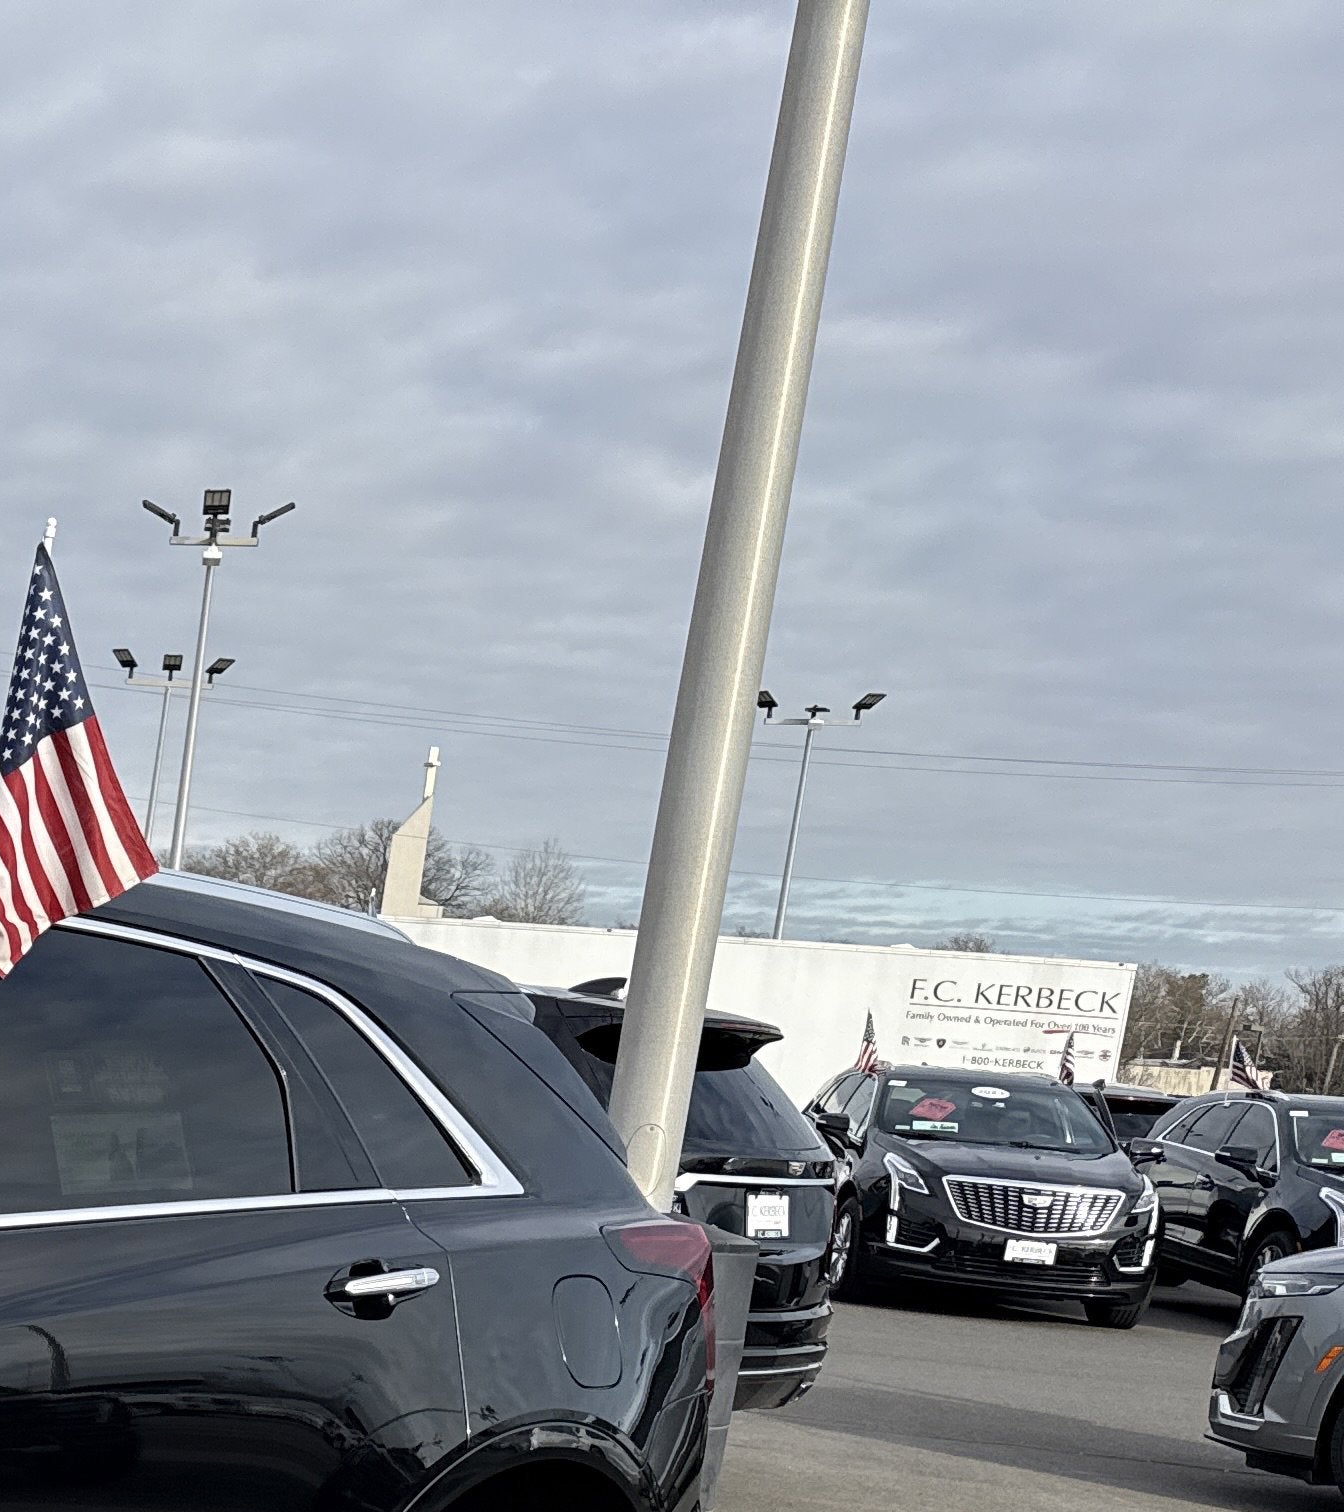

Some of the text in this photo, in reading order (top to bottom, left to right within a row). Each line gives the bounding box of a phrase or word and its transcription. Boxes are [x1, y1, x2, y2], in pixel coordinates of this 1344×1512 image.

[909, 978, 1121, 1014] F.C. KERBECK
[906, 1011, 934, 1023] Family
[937, 1013, 971, 1024] Owned
[974, 1016, 981, 1025] &
[984, 1016, 1028, 1029] Operated
[1030, 1019, 1046, 1029] For
[1091, 1024, 1116, 1035] Years
[962, 1055, 1045, 1071] 1-800-KERBECK
